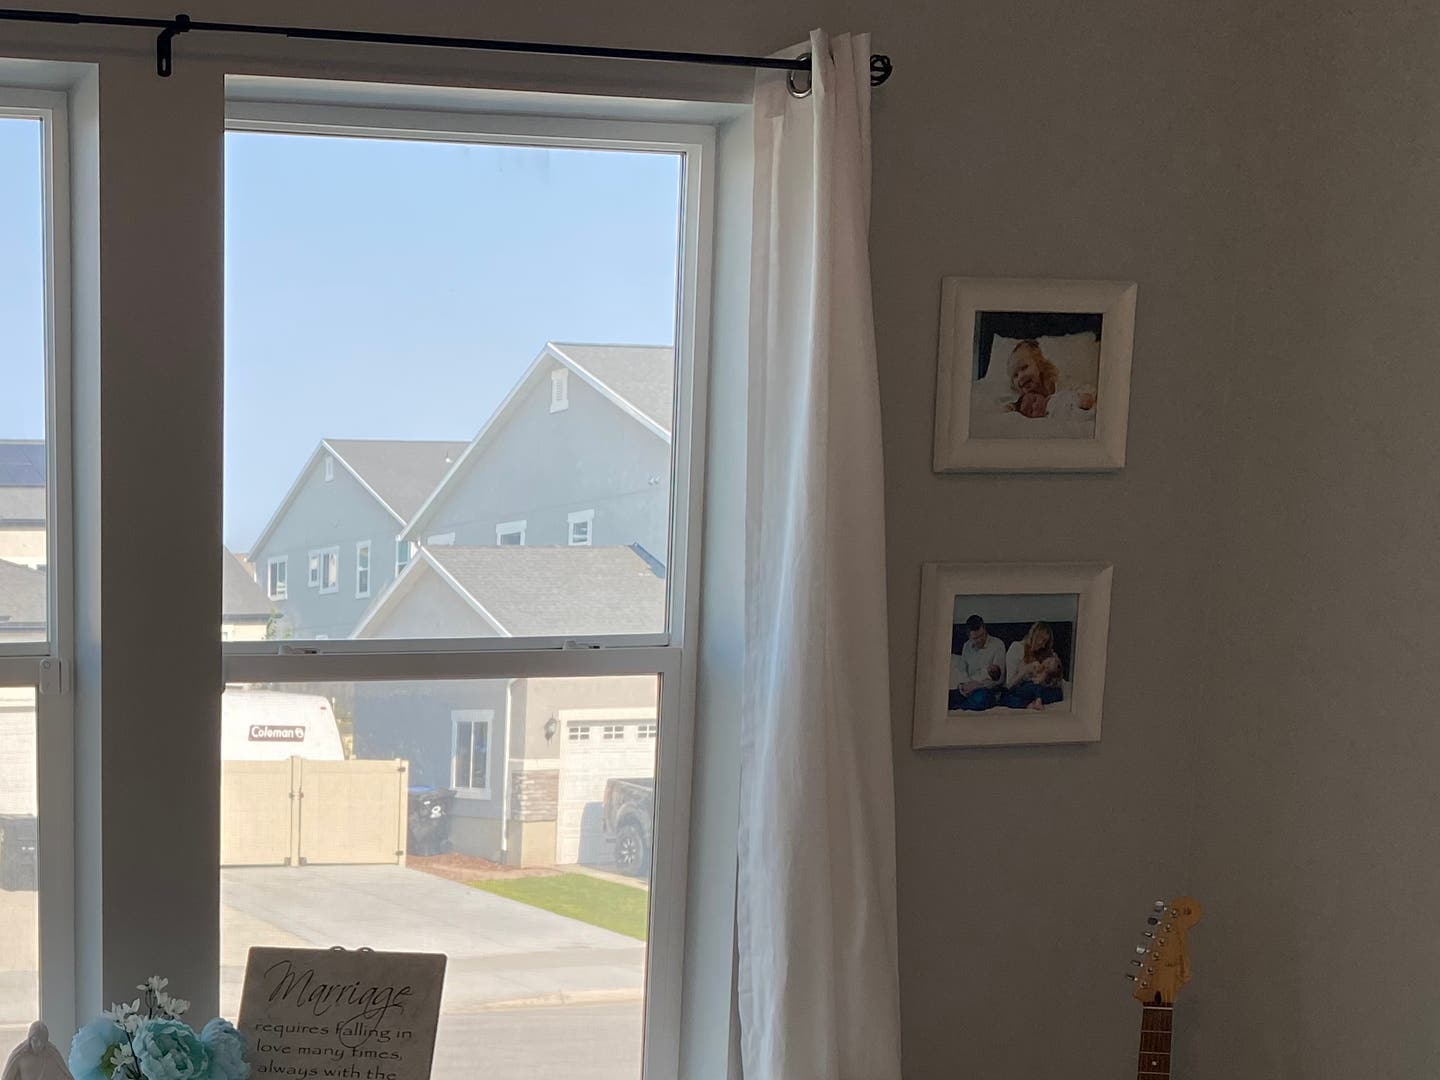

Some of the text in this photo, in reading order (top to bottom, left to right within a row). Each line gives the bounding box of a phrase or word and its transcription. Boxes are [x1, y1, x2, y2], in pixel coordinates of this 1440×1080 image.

[264, 960, 414, 1047] Marriage
[255, 1021, 412, 1043] requires falling in
[256, 1039, 403, 1061] love many times,
[256, 1060, 397, 1080] always with the
